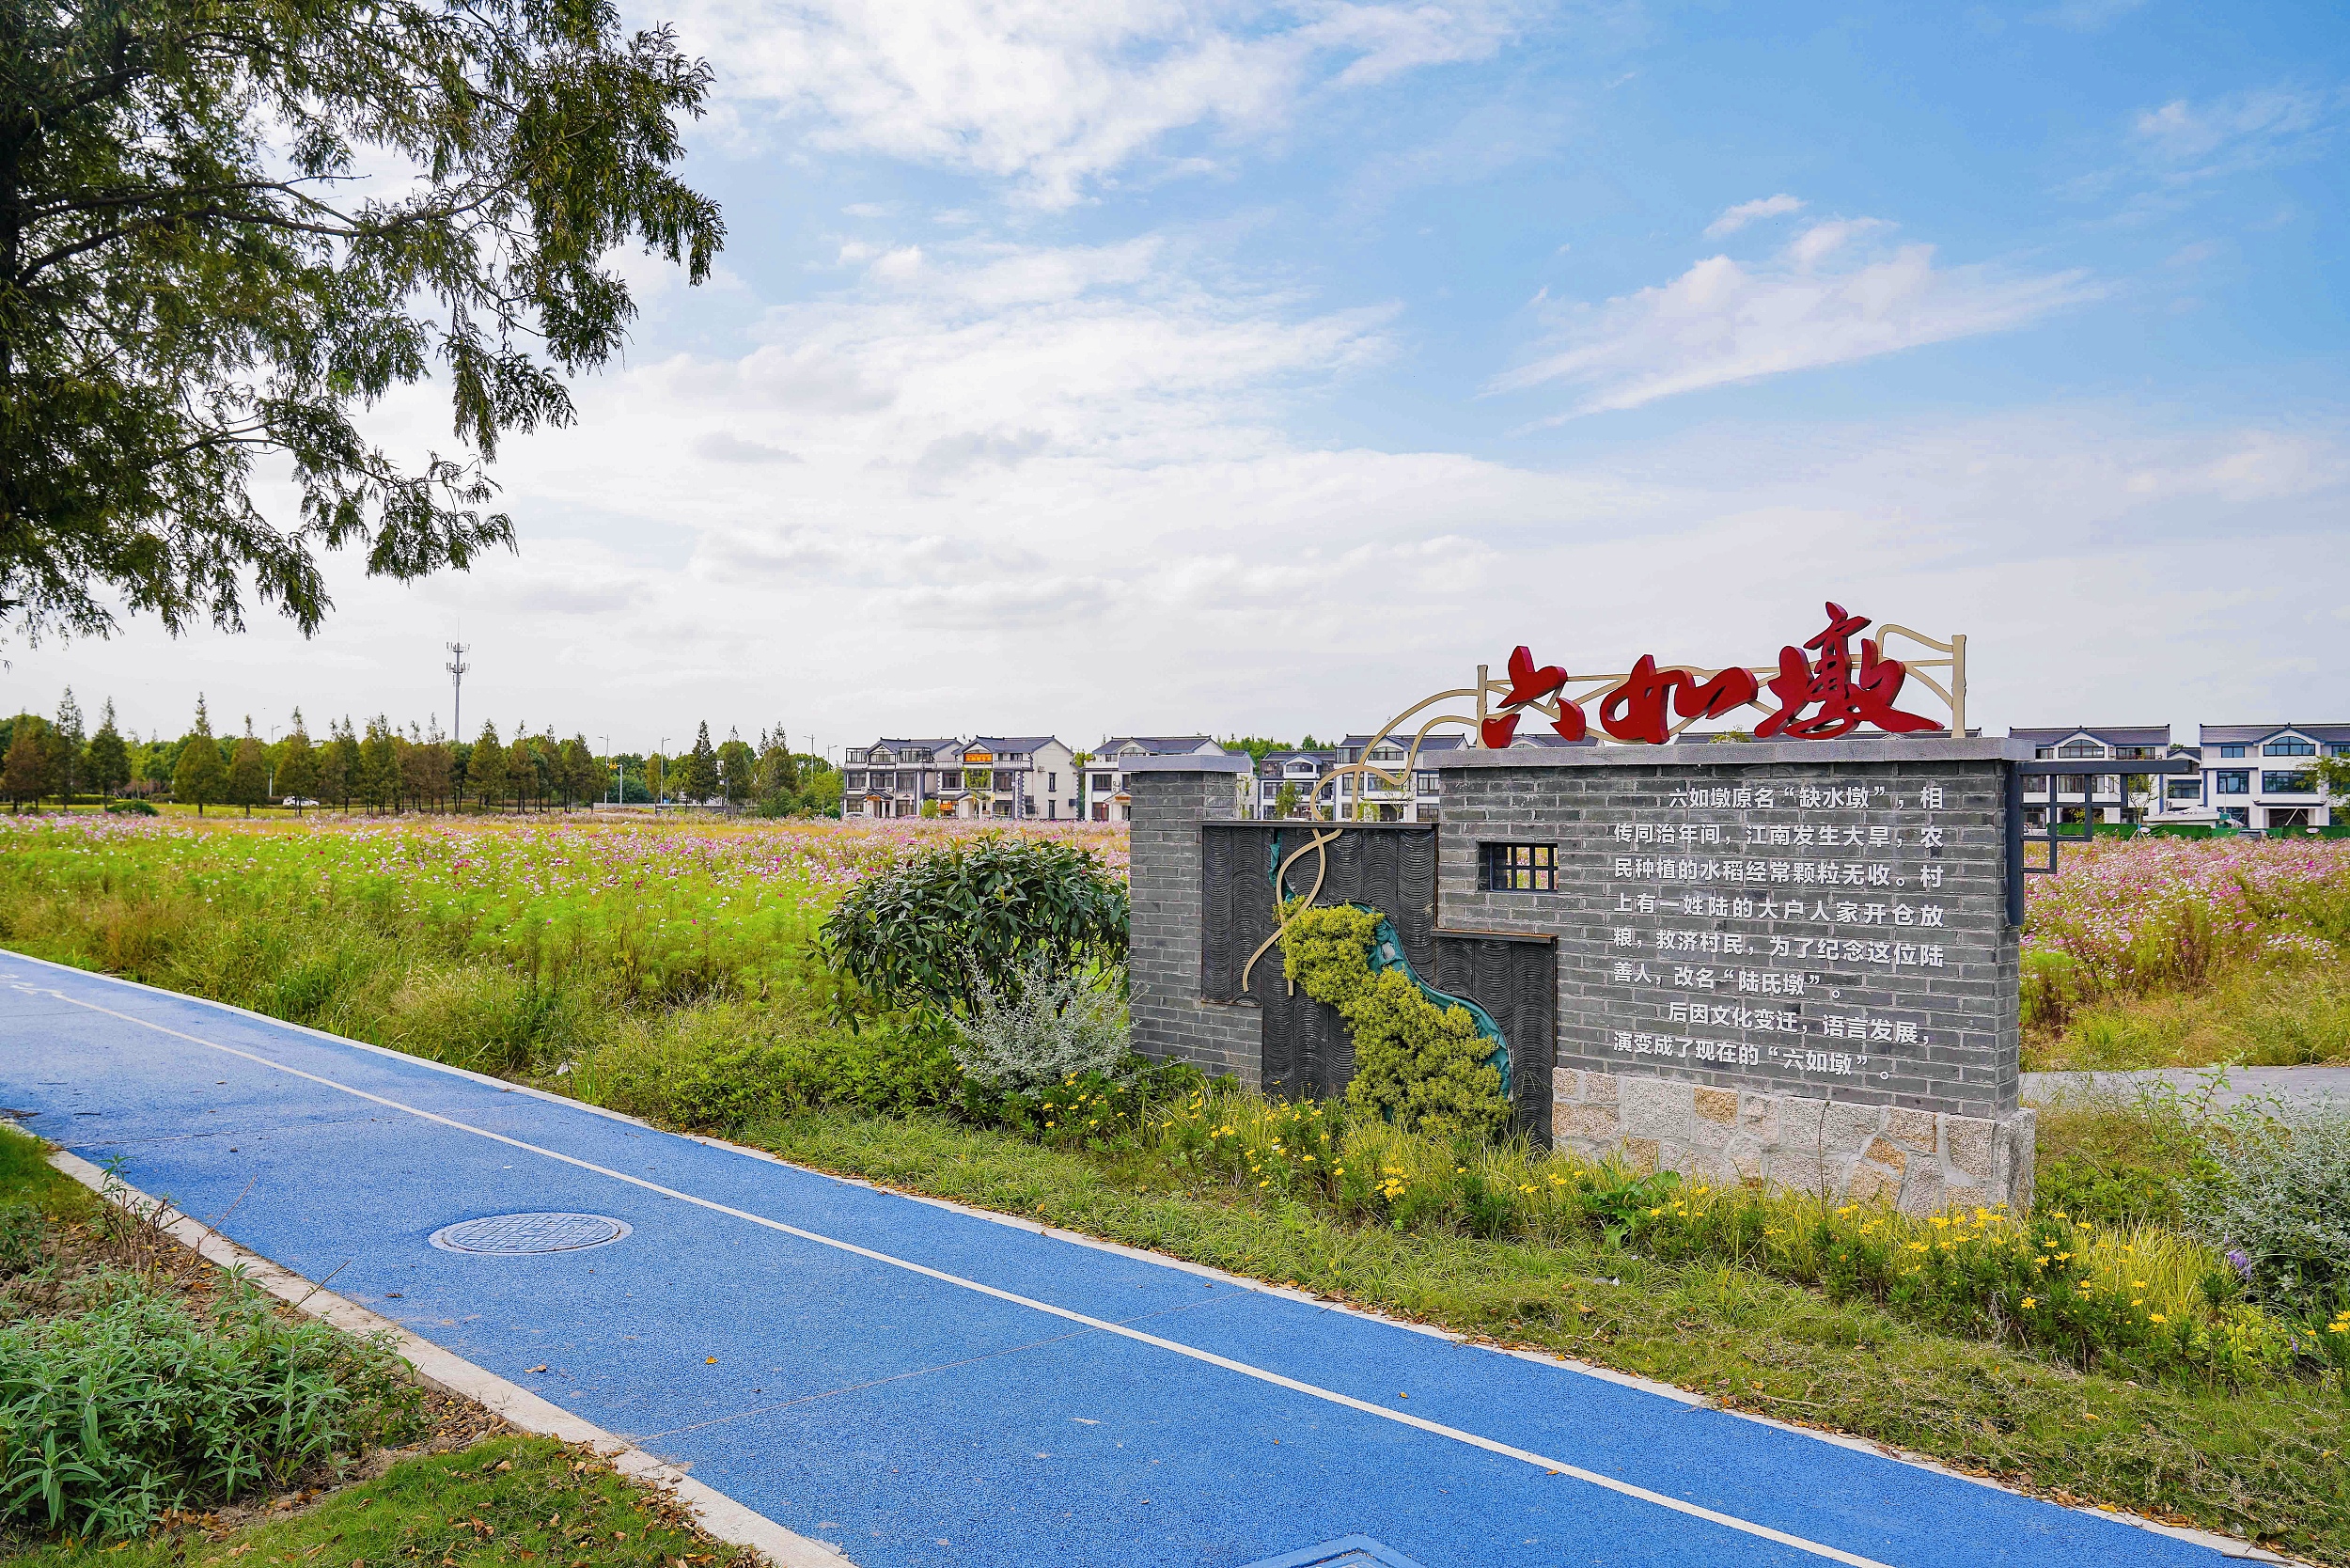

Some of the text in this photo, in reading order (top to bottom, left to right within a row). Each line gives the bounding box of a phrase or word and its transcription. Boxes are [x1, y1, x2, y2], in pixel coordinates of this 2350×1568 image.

[1668, 786, 1944, 809] 六如墩原名“缺水墩”，相
[1613, 823, 1944, 849] 传同治年间，江南发生大旱，农
[1614, 857, 1944, 888] 民种植的水稻经常颗粒无收。村
[1614, 892, 1944, 928] 上有一姓陆的大户人家开仓放
[1613, 926, 1944, 968] 粮，救济村民，为了纪念这位陆
[1668, 1001, 1930, 1046] 后因文化变迁，语言发展，
